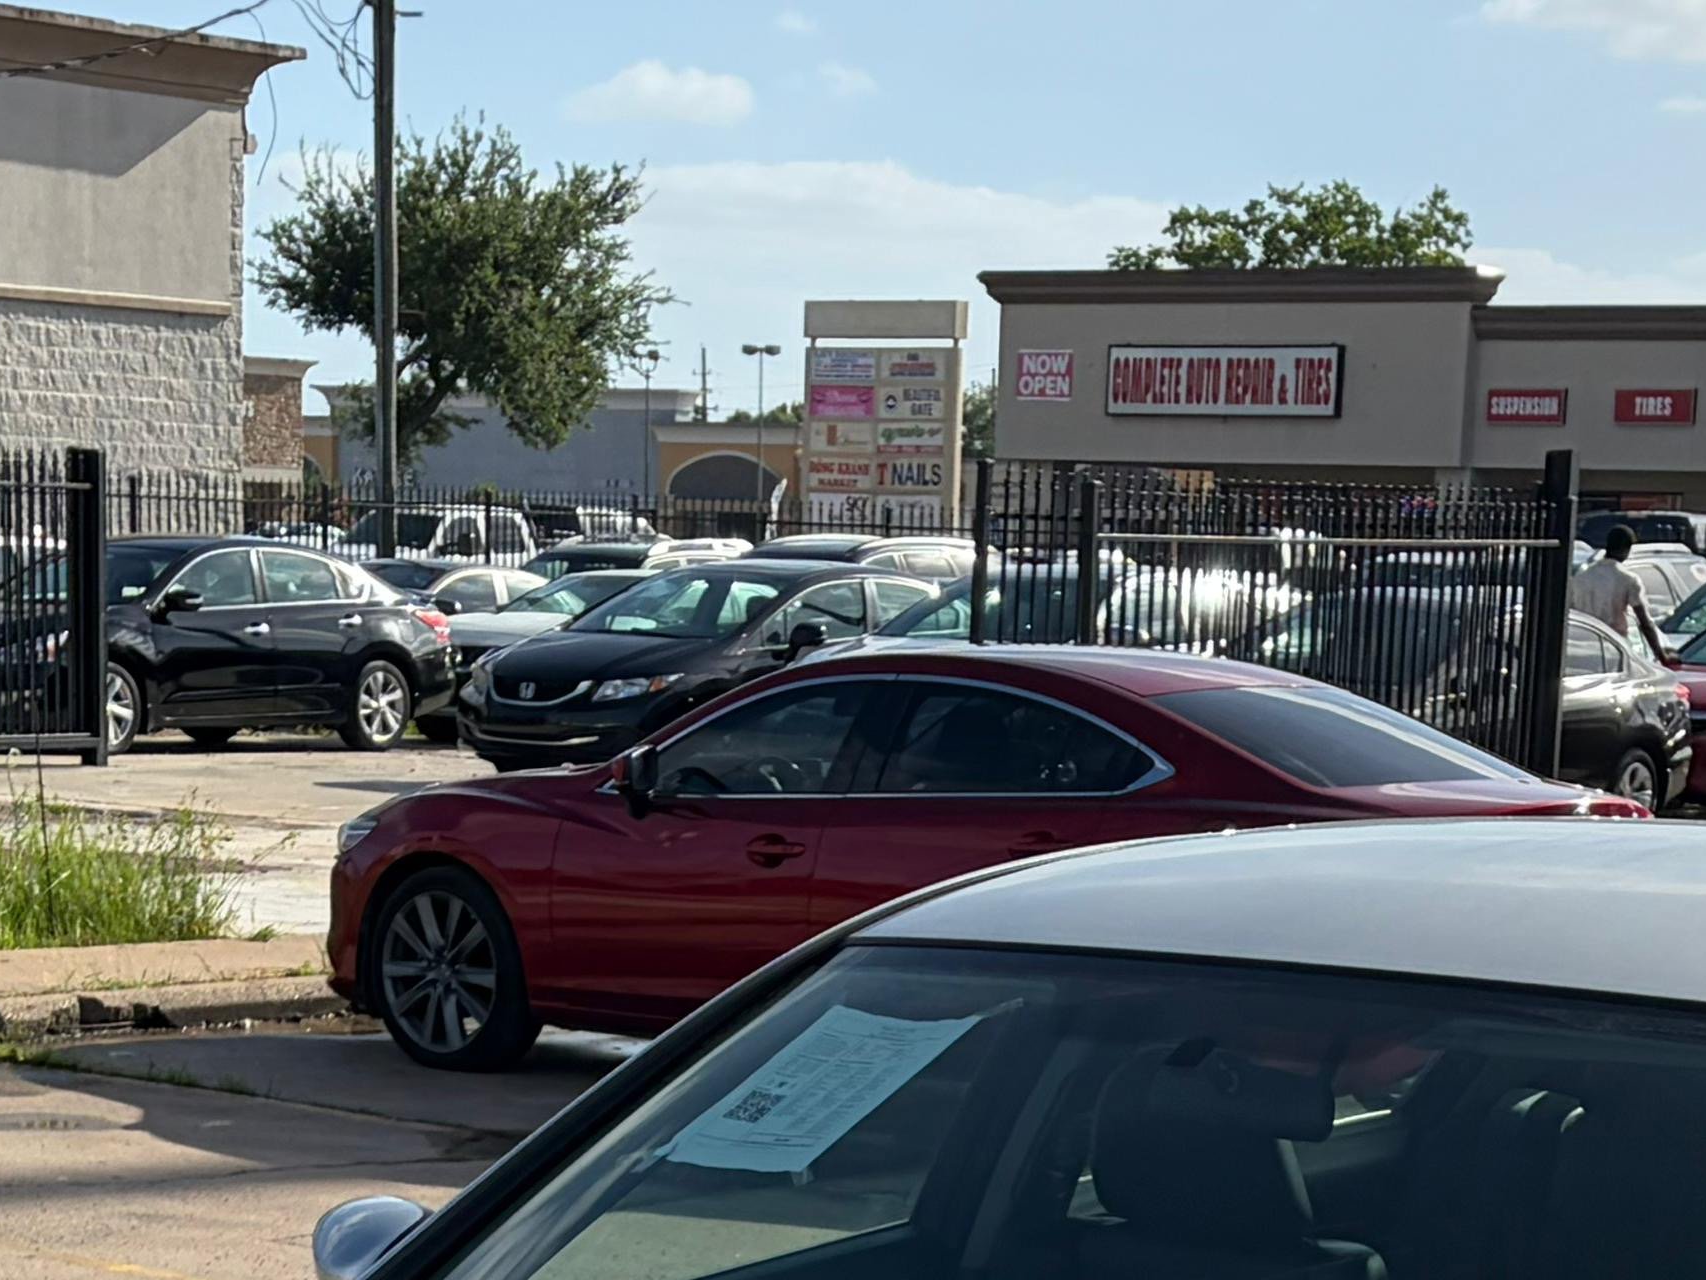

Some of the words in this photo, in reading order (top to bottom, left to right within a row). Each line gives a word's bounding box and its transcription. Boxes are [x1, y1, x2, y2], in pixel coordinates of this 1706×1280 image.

[1022, 354, 1069, 374] NOW
[1018, 375, 1070, 396] OPEN
[1112, 356, 1183, 404] COMPLETE
[1185, 357, 1221, 405] AUTO
[1224, 357, 1276, 406] REPAIR
[1278, 373, 1289, 405] &
[1294, 357, 1333, 406] TIRES
[910, 402, 935, 416] GATE
[1490, 396, 1559, 416] SUSPENSION
[1634, 396, 1673, 416] TIRES
[876, 463, 888, 486] T
[891, 462, 943, 487] NAILS
